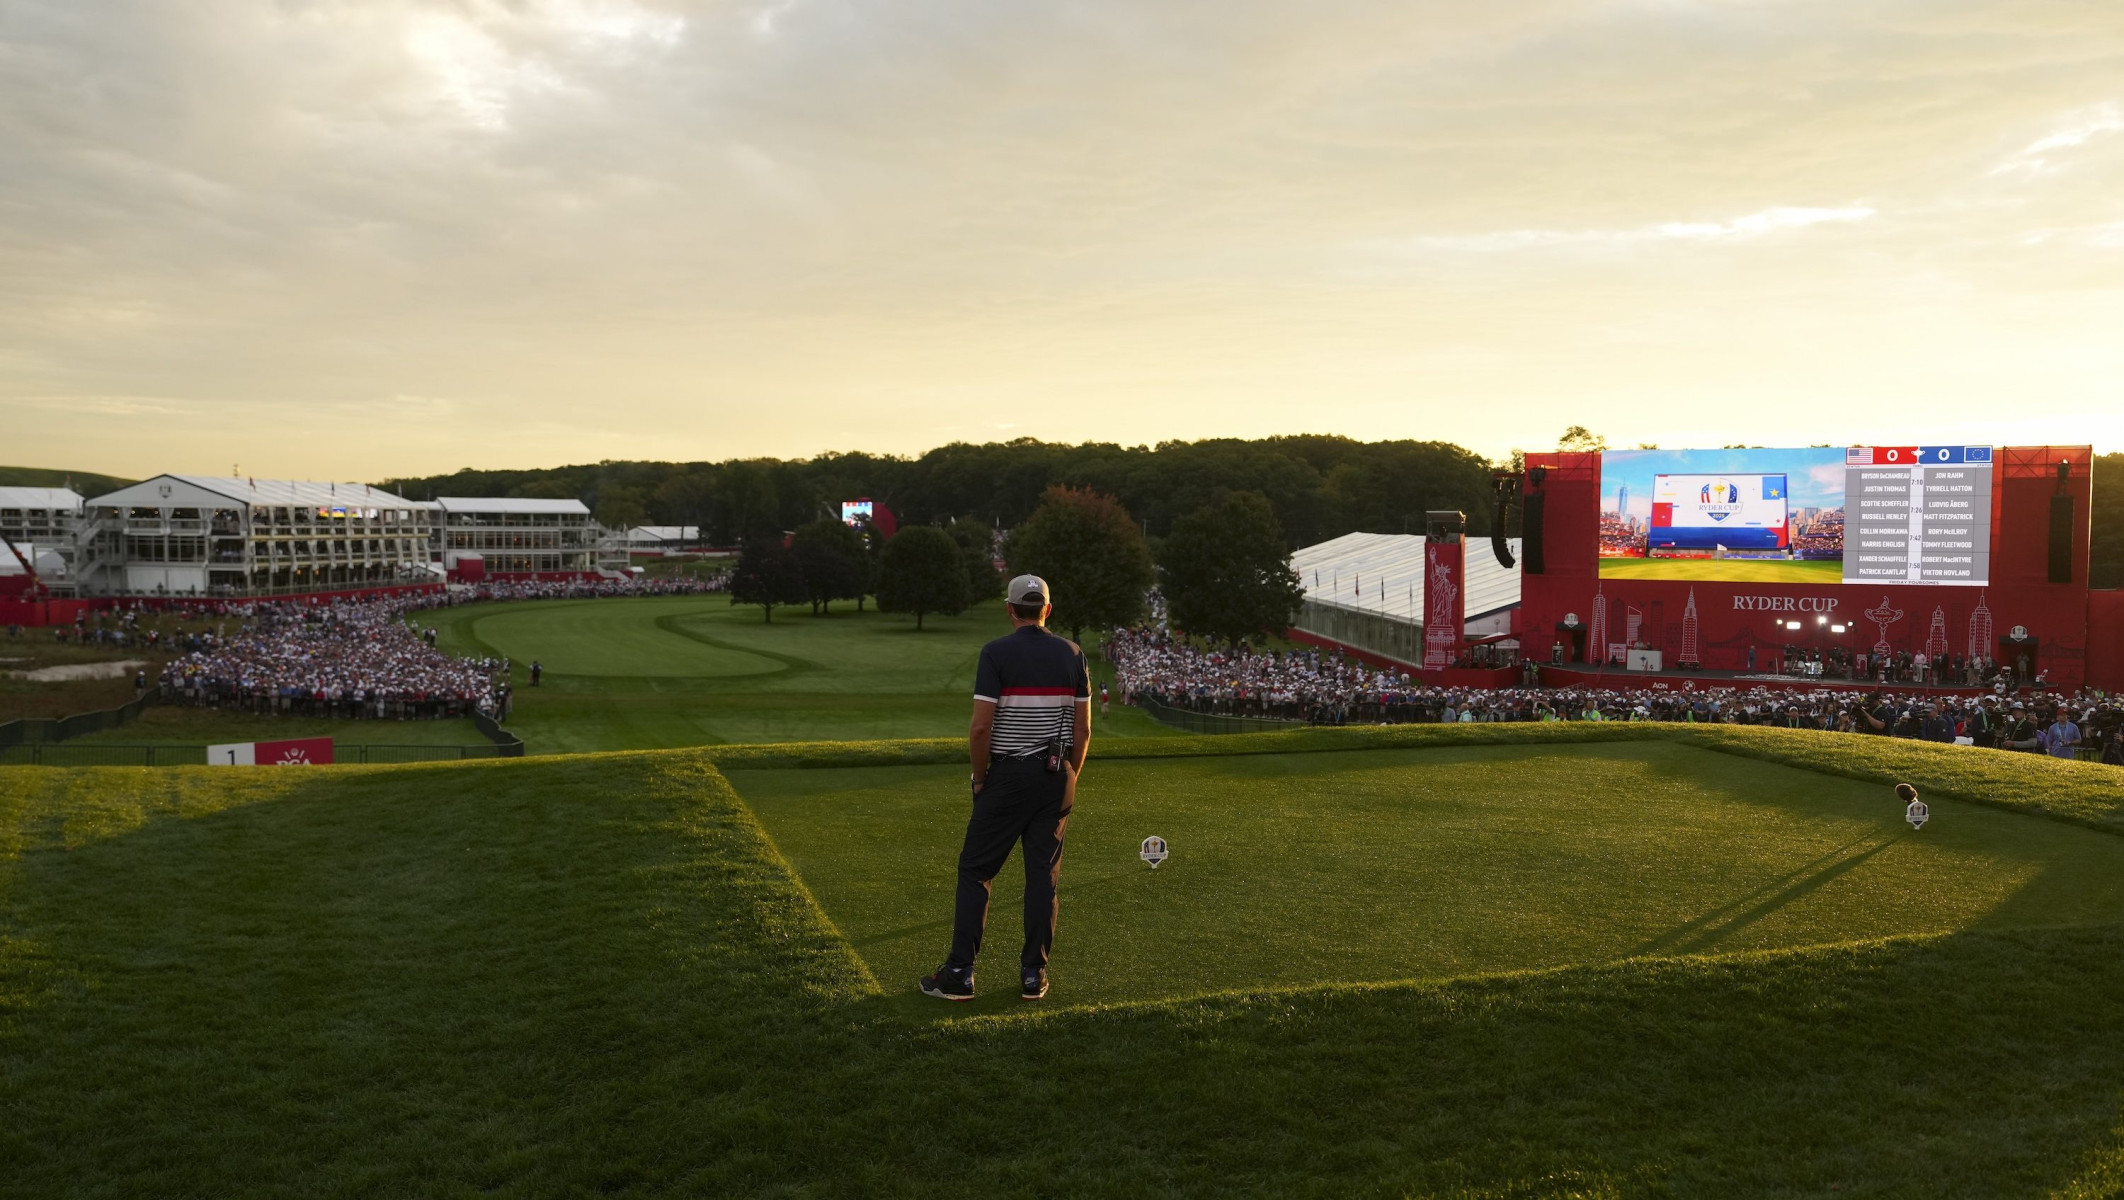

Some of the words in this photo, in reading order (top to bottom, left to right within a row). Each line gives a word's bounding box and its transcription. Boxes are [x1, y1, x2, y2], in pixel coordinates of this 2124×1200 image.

[1864, 485, 1883, 493] JUSTIN
[1884, 485, 1907, 493] THOMAS
[1922, 541, 1941, 549] TOMMY
[1941, 541, 1973, 549] FLEETWOOD
[1943, 569, 1971, 577] HOVLAND
[1732, 595, 1796, 611] RYDER
[1798, 597, 1839, 612] CUP
[227, 749, 235, 766] 1
